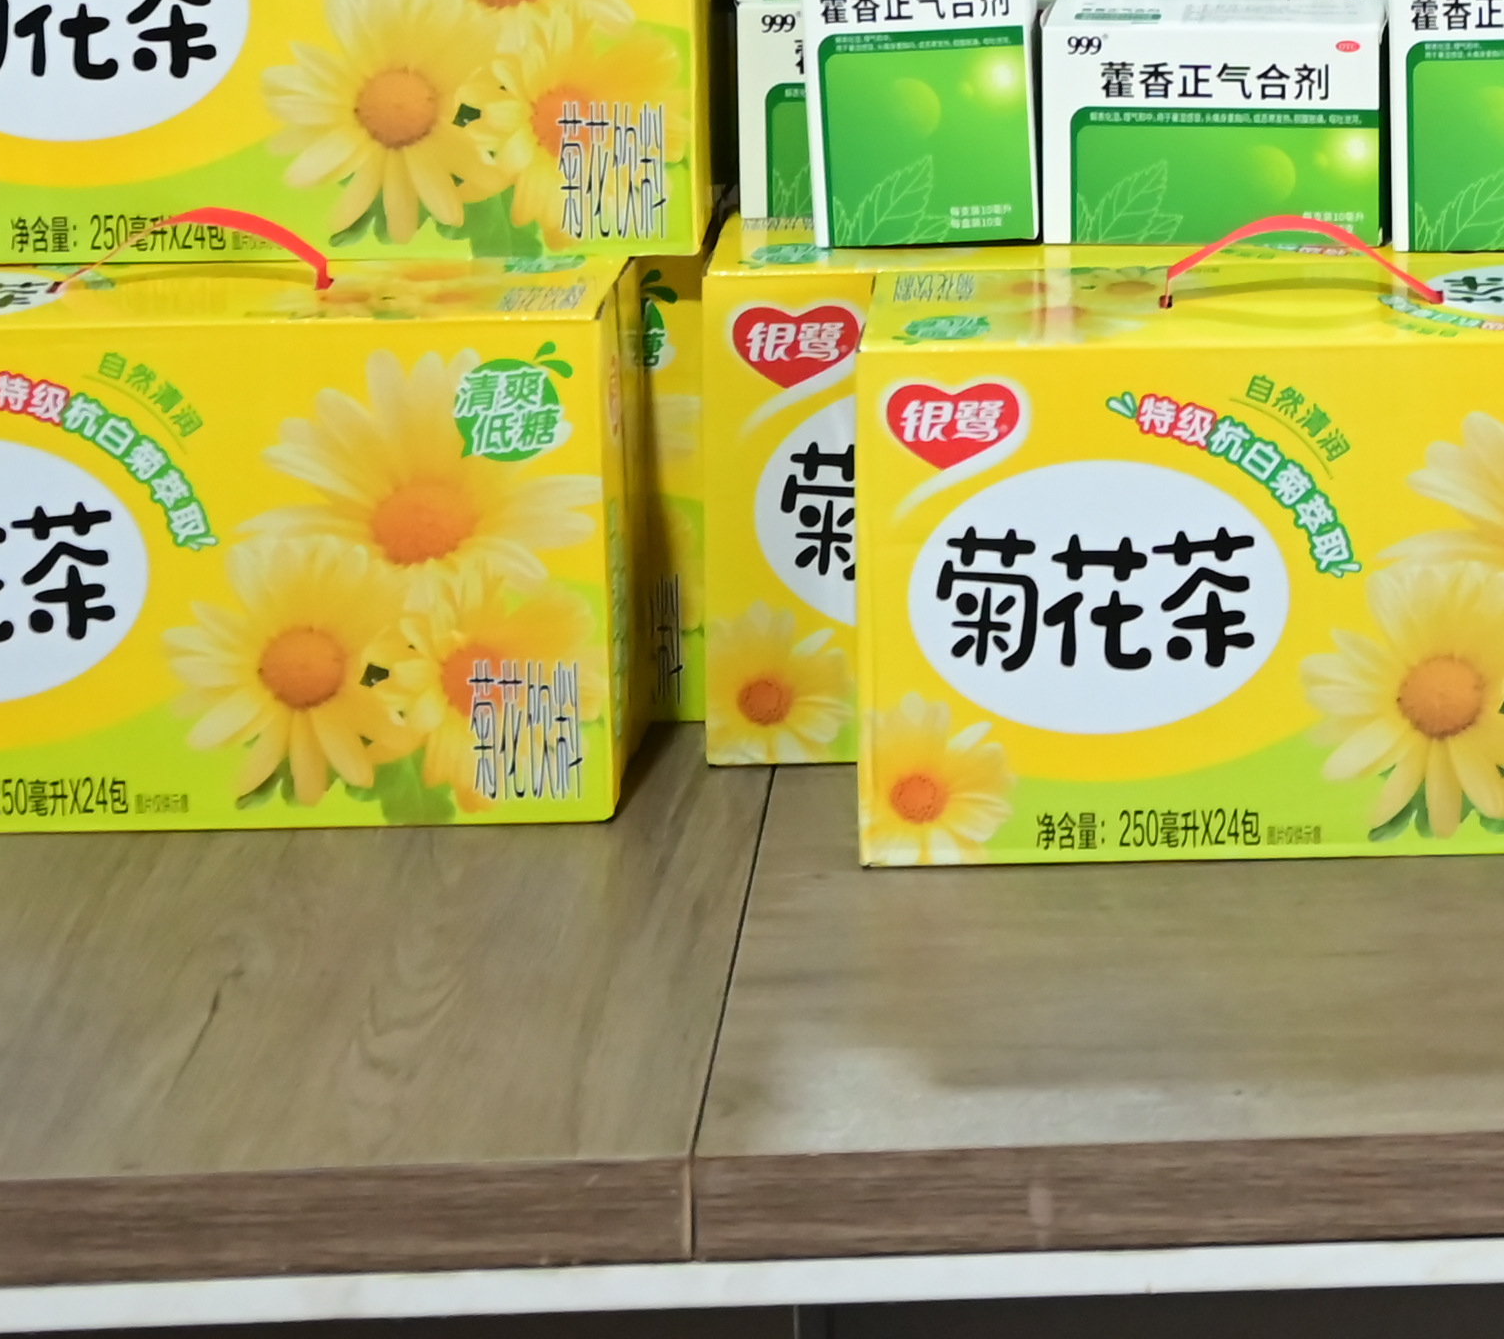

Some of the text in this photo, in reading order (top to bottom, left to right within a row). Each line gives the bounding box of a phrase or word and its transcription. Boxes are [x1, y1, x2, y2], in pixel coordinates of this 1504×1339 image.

[762, 14, 795, 32] 999
[1068, 37, 1101, 54] 999
[1101, 62, 1328, 100] 藿香正气合剂
[556, 102, 666, 240] 菊花饮料
[745, 321, 849, 362] 银鹭
[98, 350, 205, 440] 自然清润
[455, 370, 545, 419] 清爽
[1245, 373, 1350, 463] 自然清润
[472, 407, 558, 453] 低糖
[901, 399, 1007, 444] 银鹭
[935, 528, 1255, 673] 菊花茶
[469, 660, 582, 801] 菊花饮料
